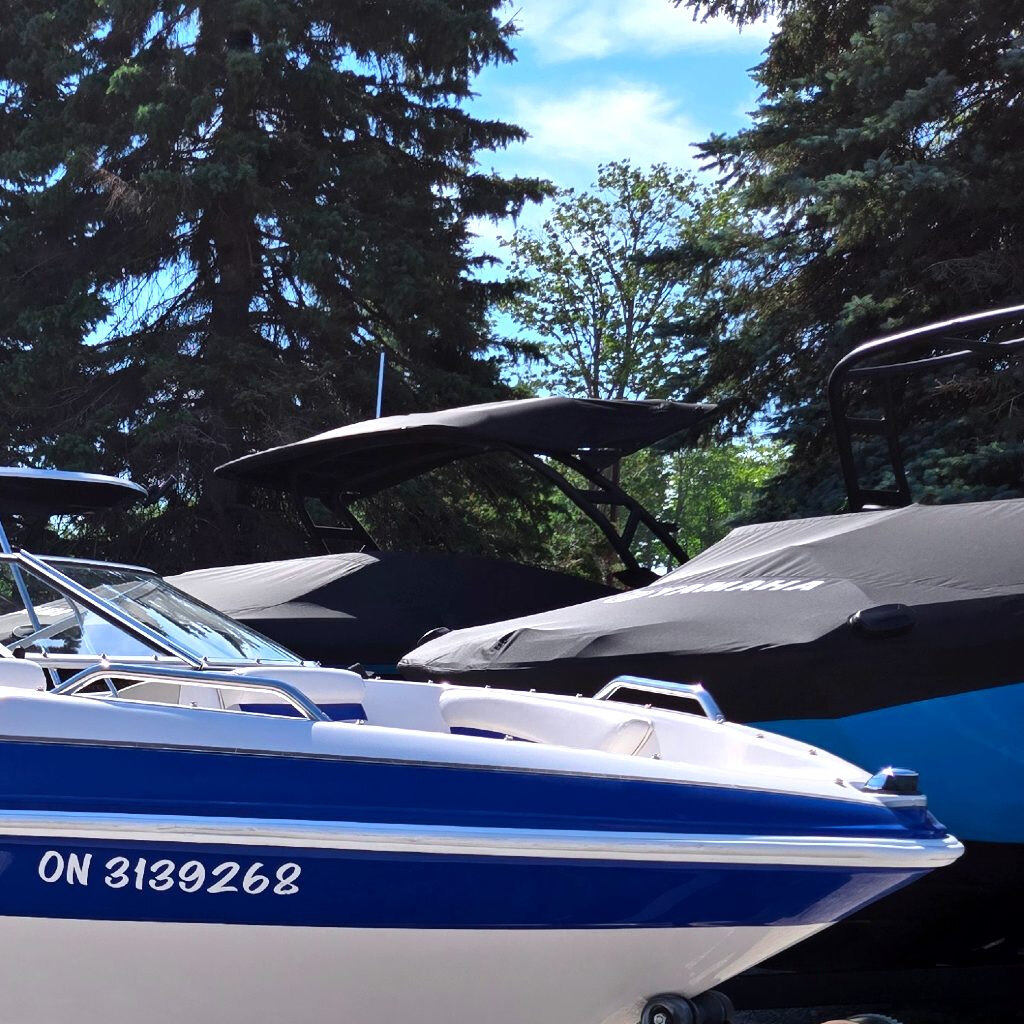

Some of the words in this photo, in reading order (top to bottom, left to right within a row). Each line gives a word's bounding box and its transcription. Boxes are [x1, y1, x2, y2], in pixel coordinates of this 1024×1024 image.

[648, 580, 825, 598] YAMAHA
[38, 850, 92, 886] ON
[105, 856, 302, 895] 3139268
